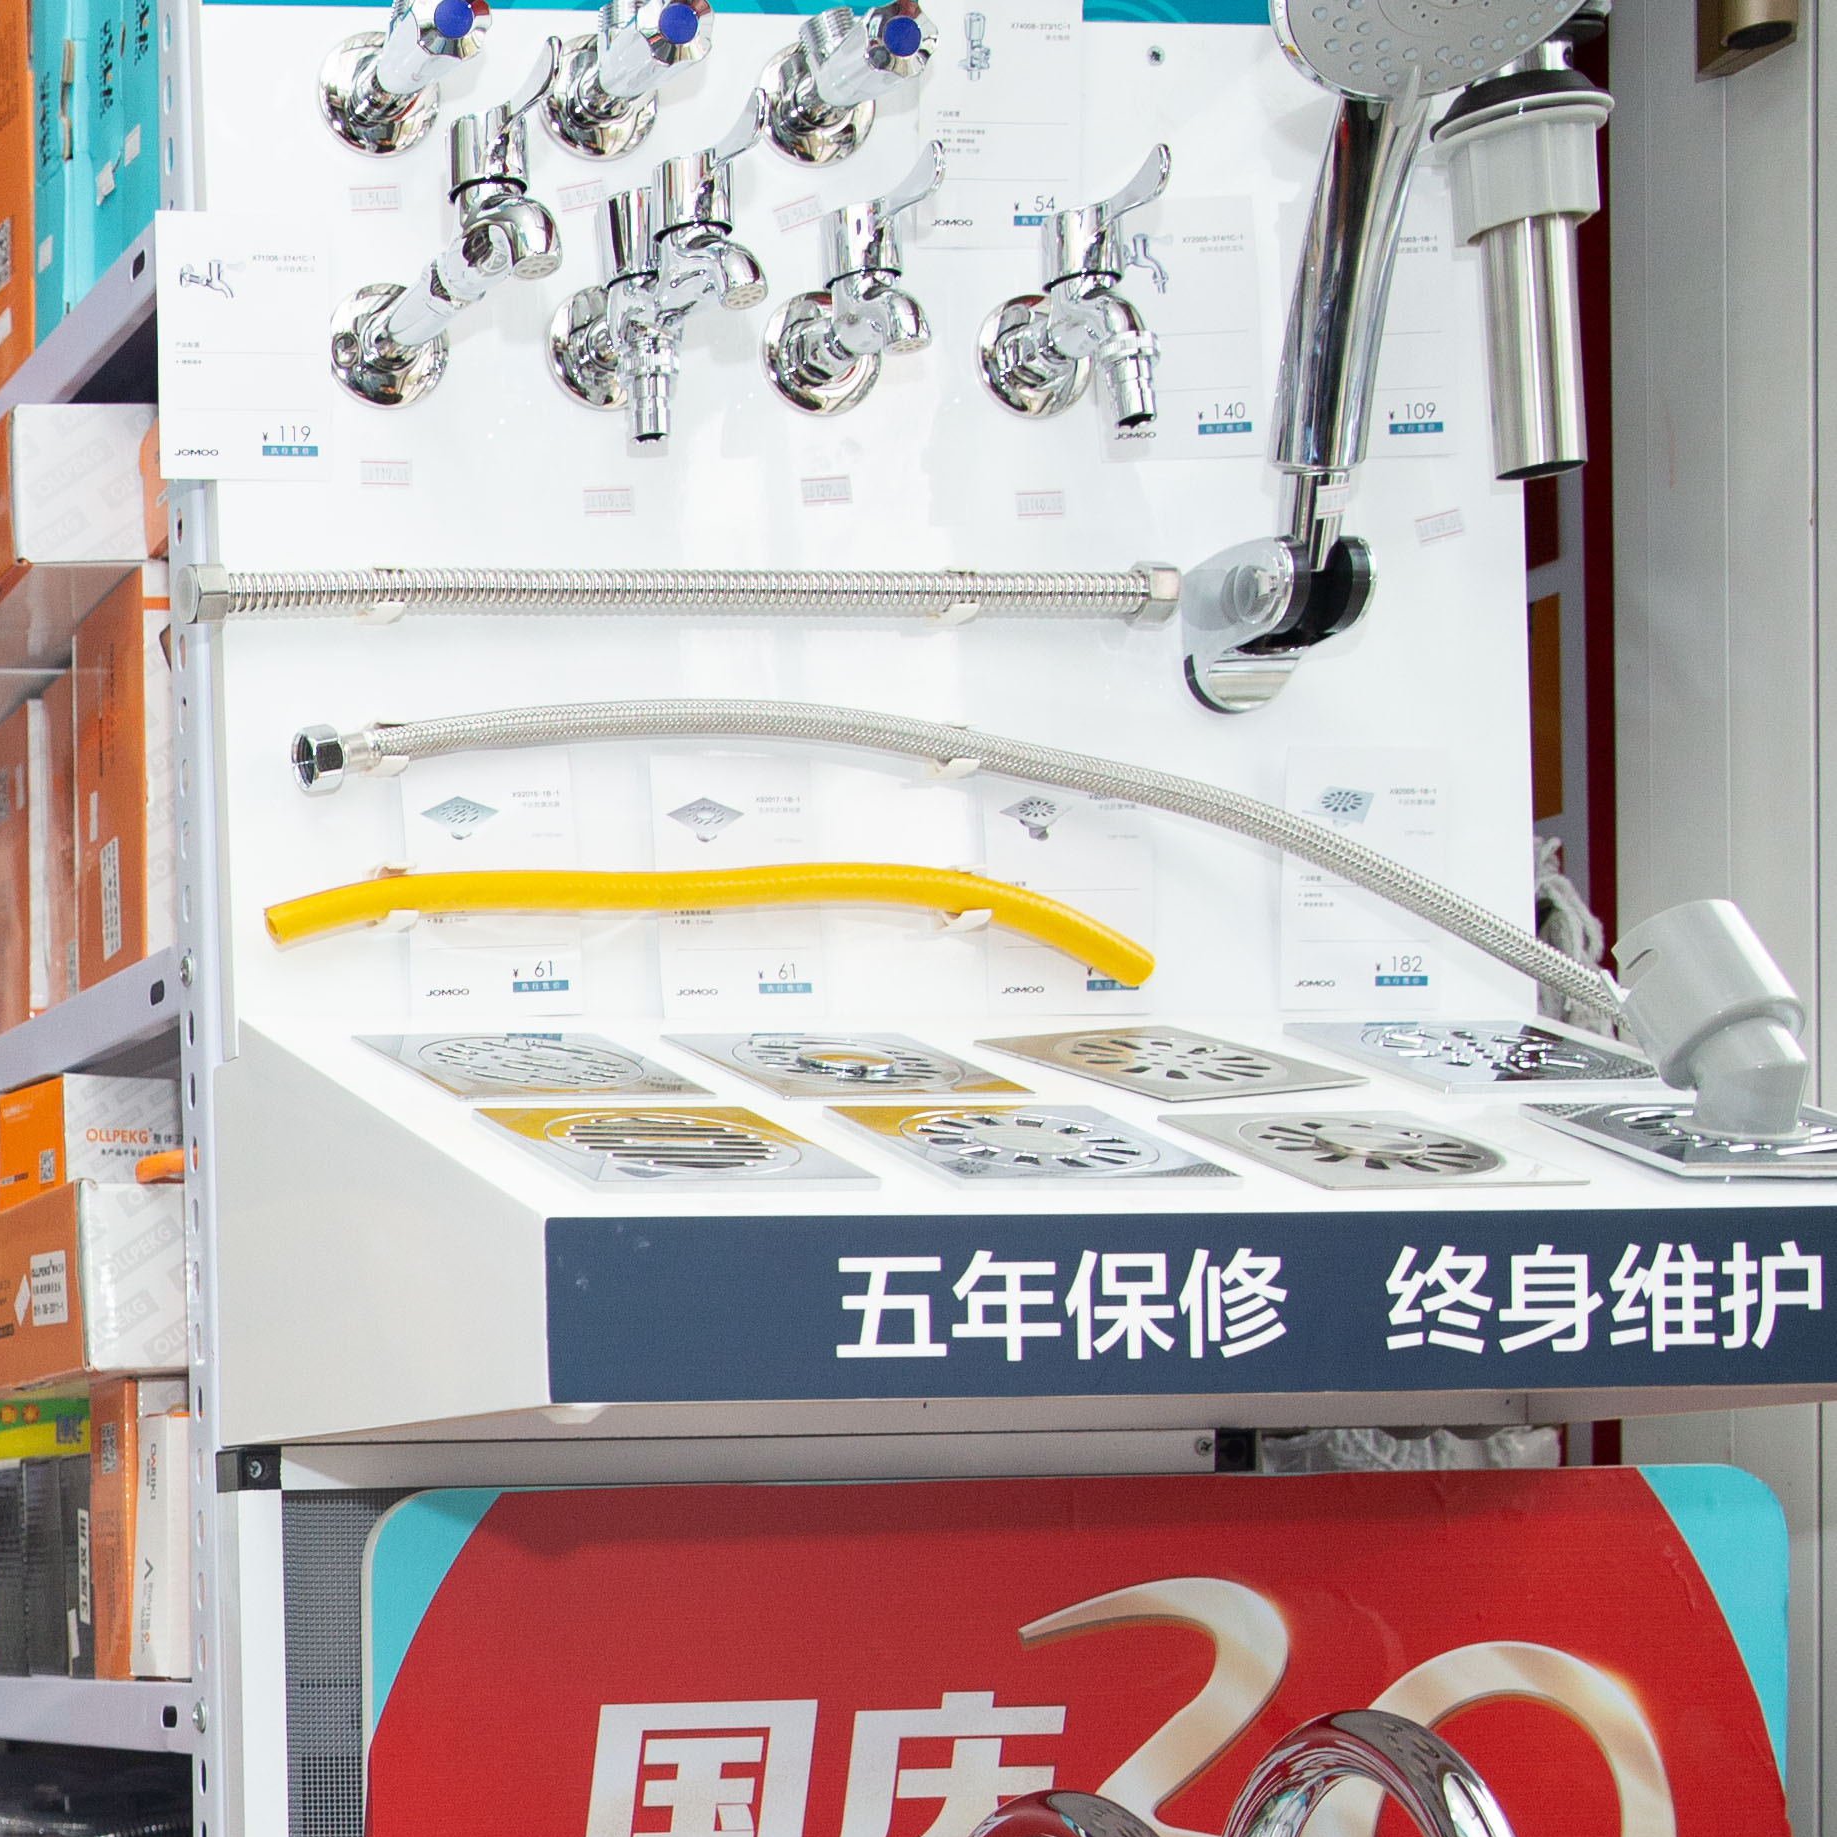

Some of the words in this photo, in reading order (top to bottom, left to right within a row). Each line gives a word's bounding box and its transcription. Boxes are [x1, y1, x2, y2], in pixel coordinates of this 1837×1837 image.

[1034, 195, 1057, 212] 54
[931, 219, 974, 227] JOMOO
[1214, 402, 1246, 420] 140
[1404, 402, 1437, 420] 109
[279, 425, 312, 442] 119
[1114, 431, 1157, 440] JOMOO
[174, 448, 219, 457] JOMOO
[534, 960, 556, 977] 61
[779, 963, 799, 980] 61
[1390, 955, 1424, 972] 182
[676, 987, 719, 996] JOMOO
[1002, 984, 1045, 993] JOMOO
[1295, 979, 1336, 987] JOMOO
[425, 987, 470, 997] JOMOO
[86, 1127, 149, 1145] OLLPEKG
[837, 1248, 1288, 1362] 五年保修
[1385, 1242, 1823, 1354] 终身维护
